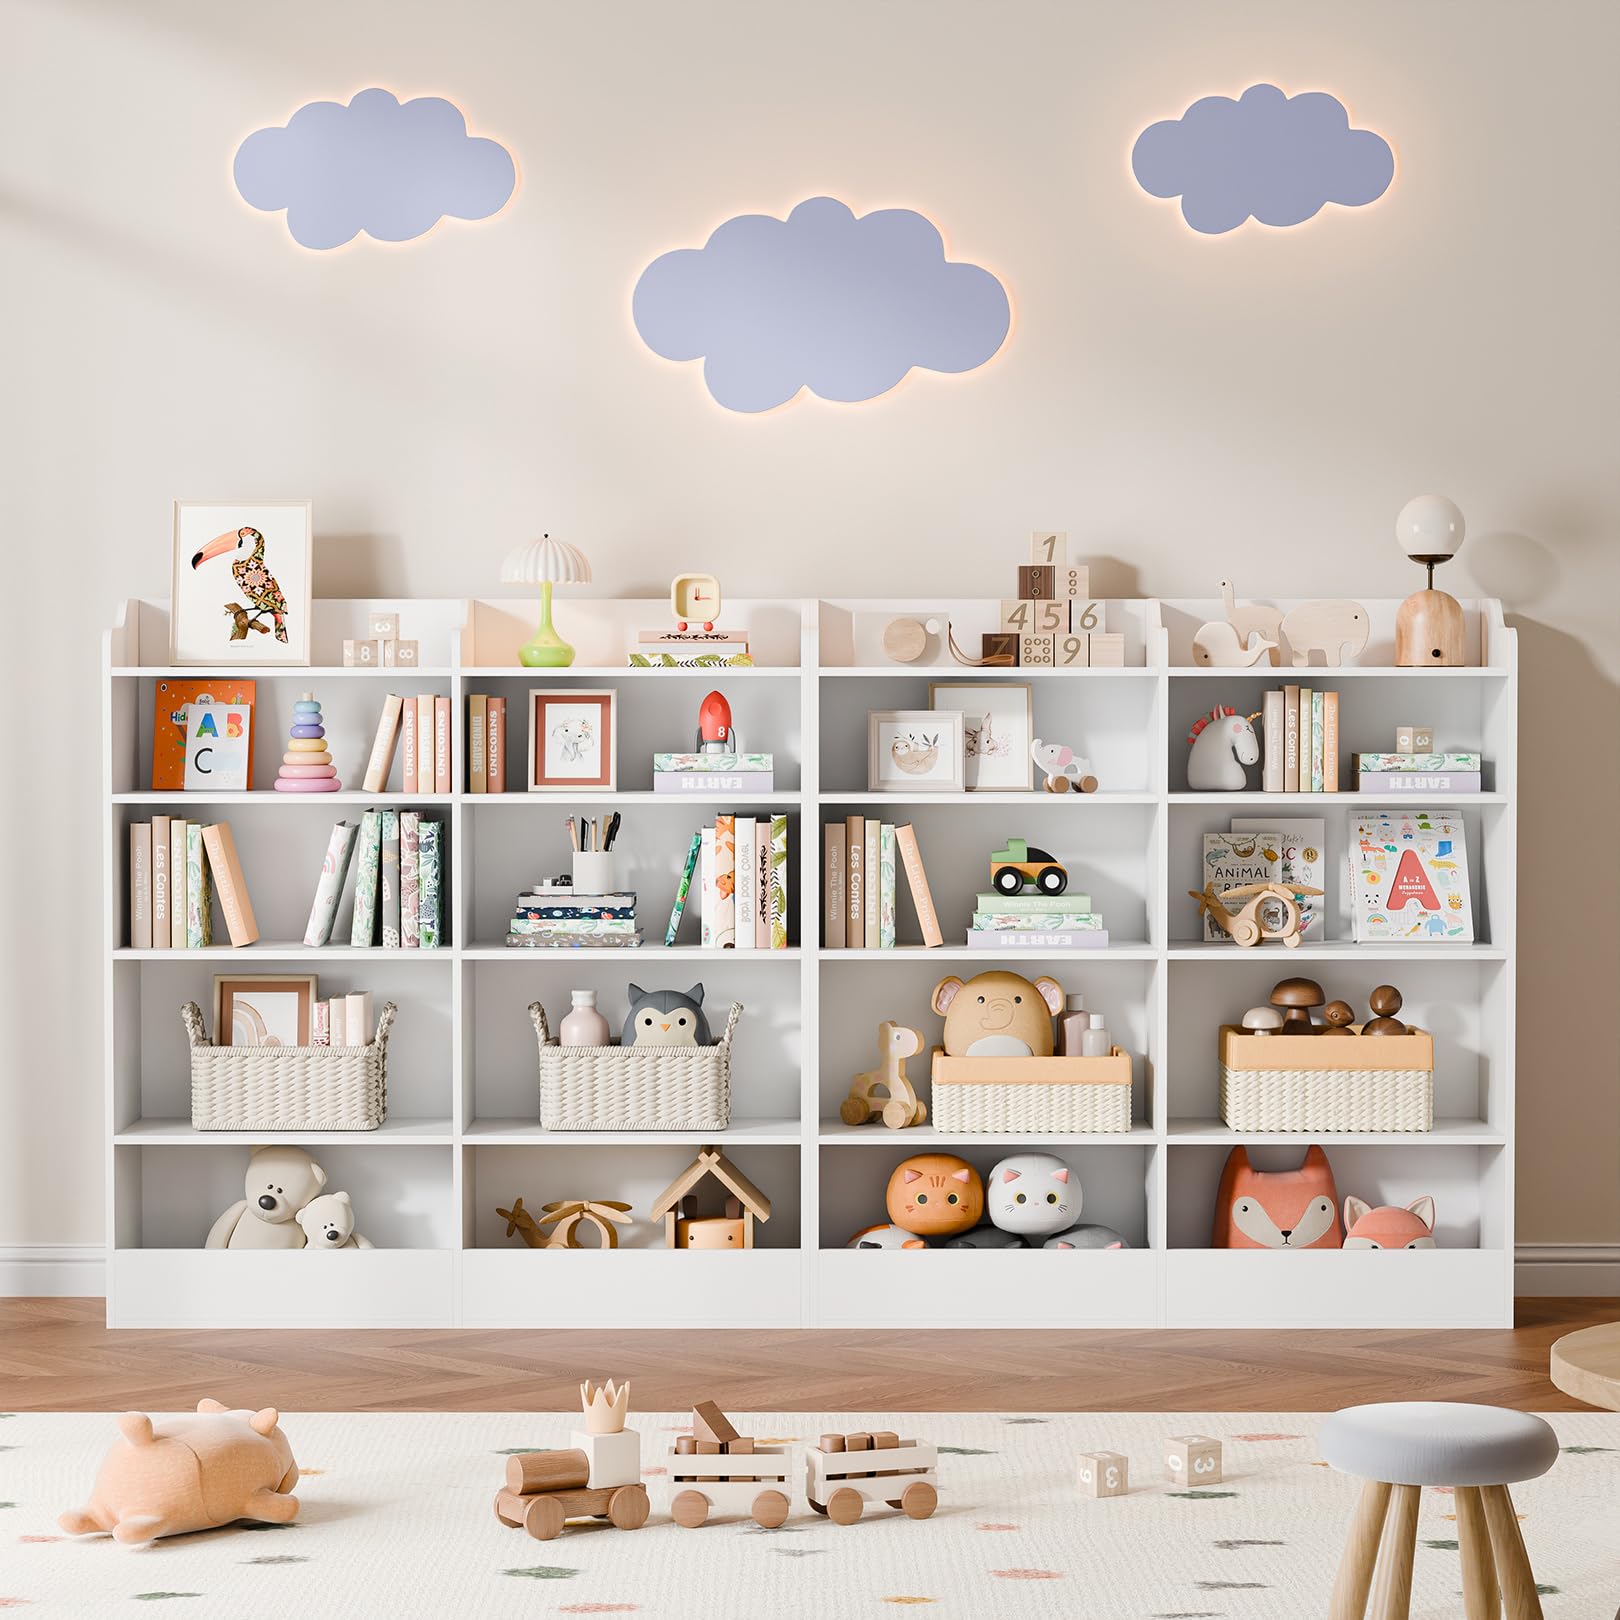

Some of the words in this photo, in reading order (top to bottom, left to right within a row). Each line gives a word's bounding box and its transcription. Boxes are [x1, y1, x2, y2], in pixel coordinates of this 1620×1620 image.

[1042, 535, 1057, 562] 1
[1007, 603, 1028, 630] 4
[1042, 603, 1062, 630] 5
[1079, 603, 1098, 630] 6
[361, 646, 371, 662] 8
[1063, 637, 1081, 664] 9
[195, 712, 219, 738] A
[227, 712, 244, 738] B
[1288, 708, 1297, 728] Les
[405, 710, 414, 777] UNICORNS
[437, 710, 446, 777] UNICORNS
[472, 715, 483, 773] DINOSAURS
[489, 710, 498, 777] UNICORNS
[718, 726, 726, 738] 8
[1416, 735, 1429, 746] 3
[194, 747, 213, 774] C
[1288, 731, 1297, 769] Contes
[681, 776, 743, 789] EARTH
[1389, 777, 1451, 789] EARTH
[156, 845, 166, 869] Les
[851, 845, 861, 869] Les
[156, 873, 166, 920] Contes
[851, 873, 861, 920] Contes
[1105, 1466, 1118, 1489] 3
[1193, 1456, 1215, 1474] 3
